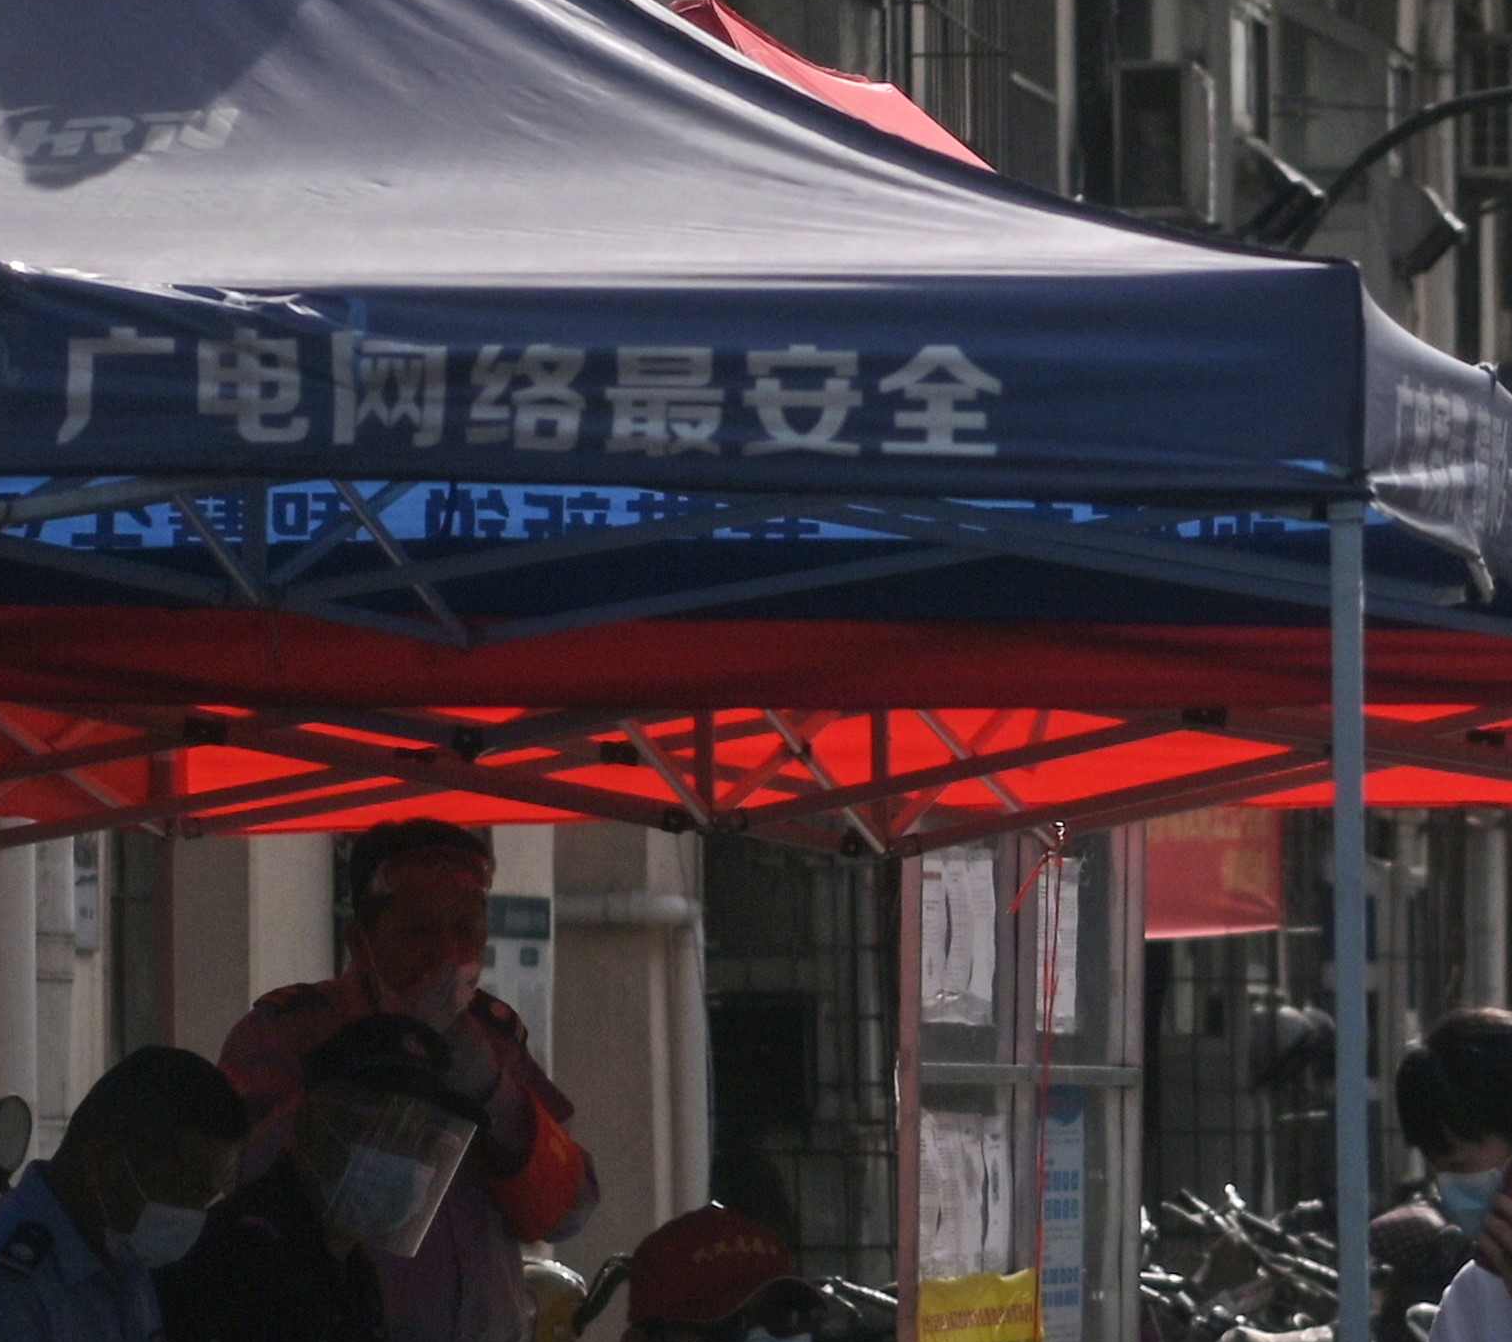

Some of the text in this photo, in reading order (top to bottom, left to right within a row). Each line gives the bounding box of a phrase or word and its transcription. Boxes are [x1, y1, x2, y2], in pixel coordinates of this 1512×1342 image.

[56, 324, 1005, 459] 广电网络最安全
